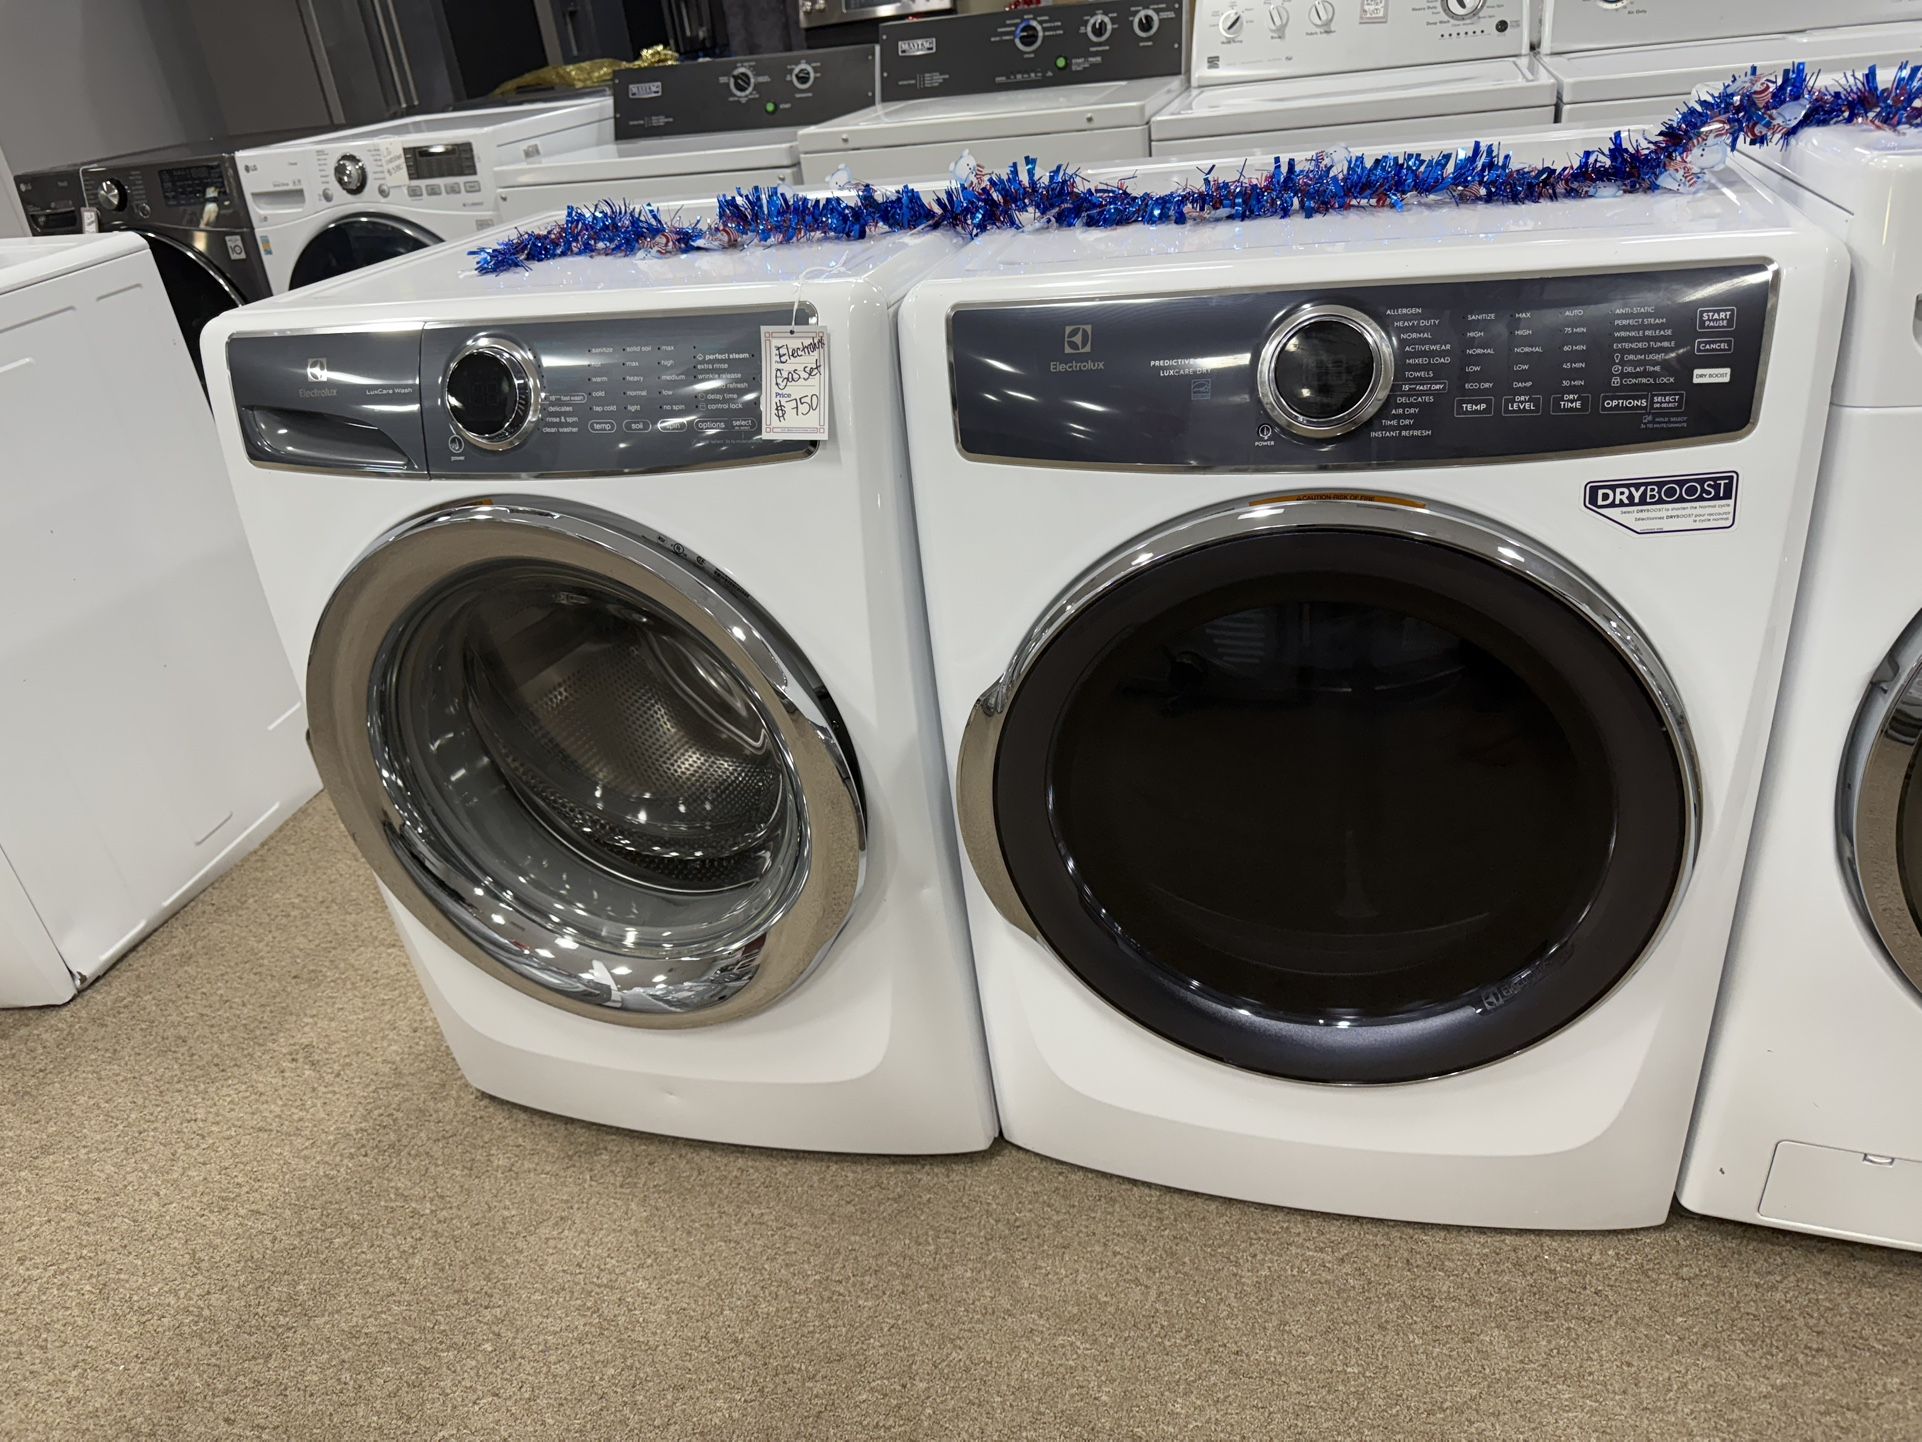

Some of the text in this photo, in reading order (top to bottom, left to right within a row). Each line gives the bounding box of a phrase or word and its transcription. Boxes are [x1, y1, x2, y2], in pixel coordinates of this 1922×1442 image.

[1050, 360, 1104, 372] Electrolux
[1150, 358, 1194, 367] PREDICTIVE
[775, 366, 801, 390] Gas
[299, 388, 337, 398] Electrolux
[366, 386, 412, 395] LuxCare Wash
[1604, 399, 1647, 408] OPTIONS
[698, 421, 725, 429] options
[1597, 480, 1729, 506] DRYBOOST
